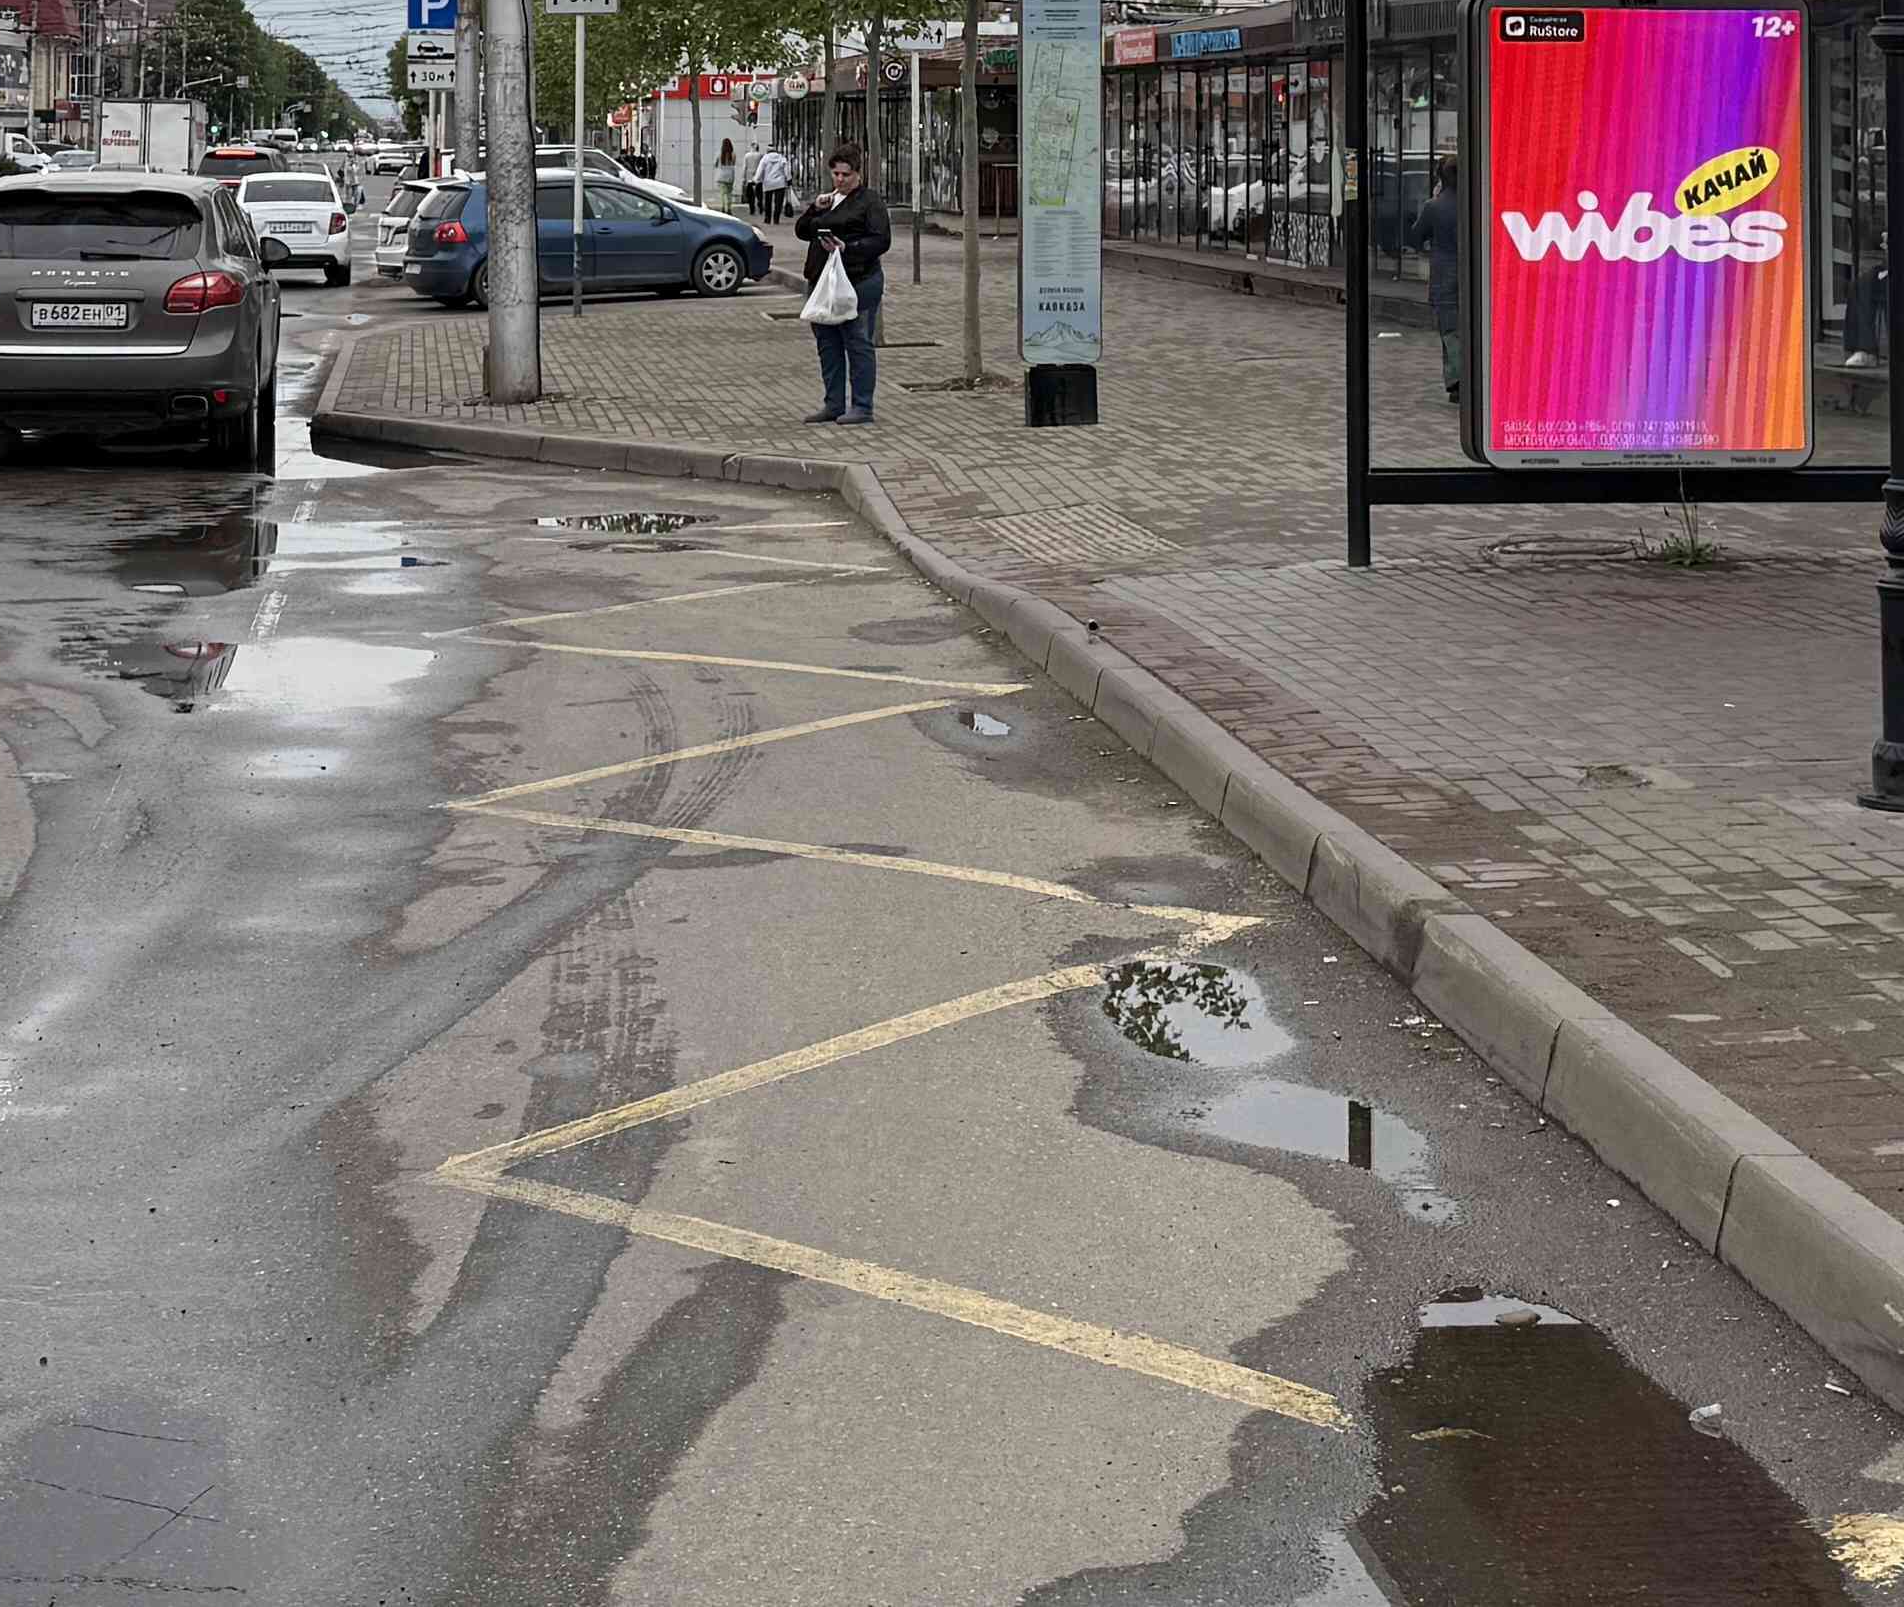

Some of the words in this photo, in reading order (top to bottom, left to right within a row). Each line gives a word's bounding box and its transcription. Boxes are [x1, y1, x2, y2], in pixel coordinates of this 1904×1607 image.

[1529, 25, 1578, 37] RuStore
[1752, 16, 1795, 38] 12+
[1683, 149, 1768, 210] КАЧАЙ
[1500, 190, 1788, 263] wibes
